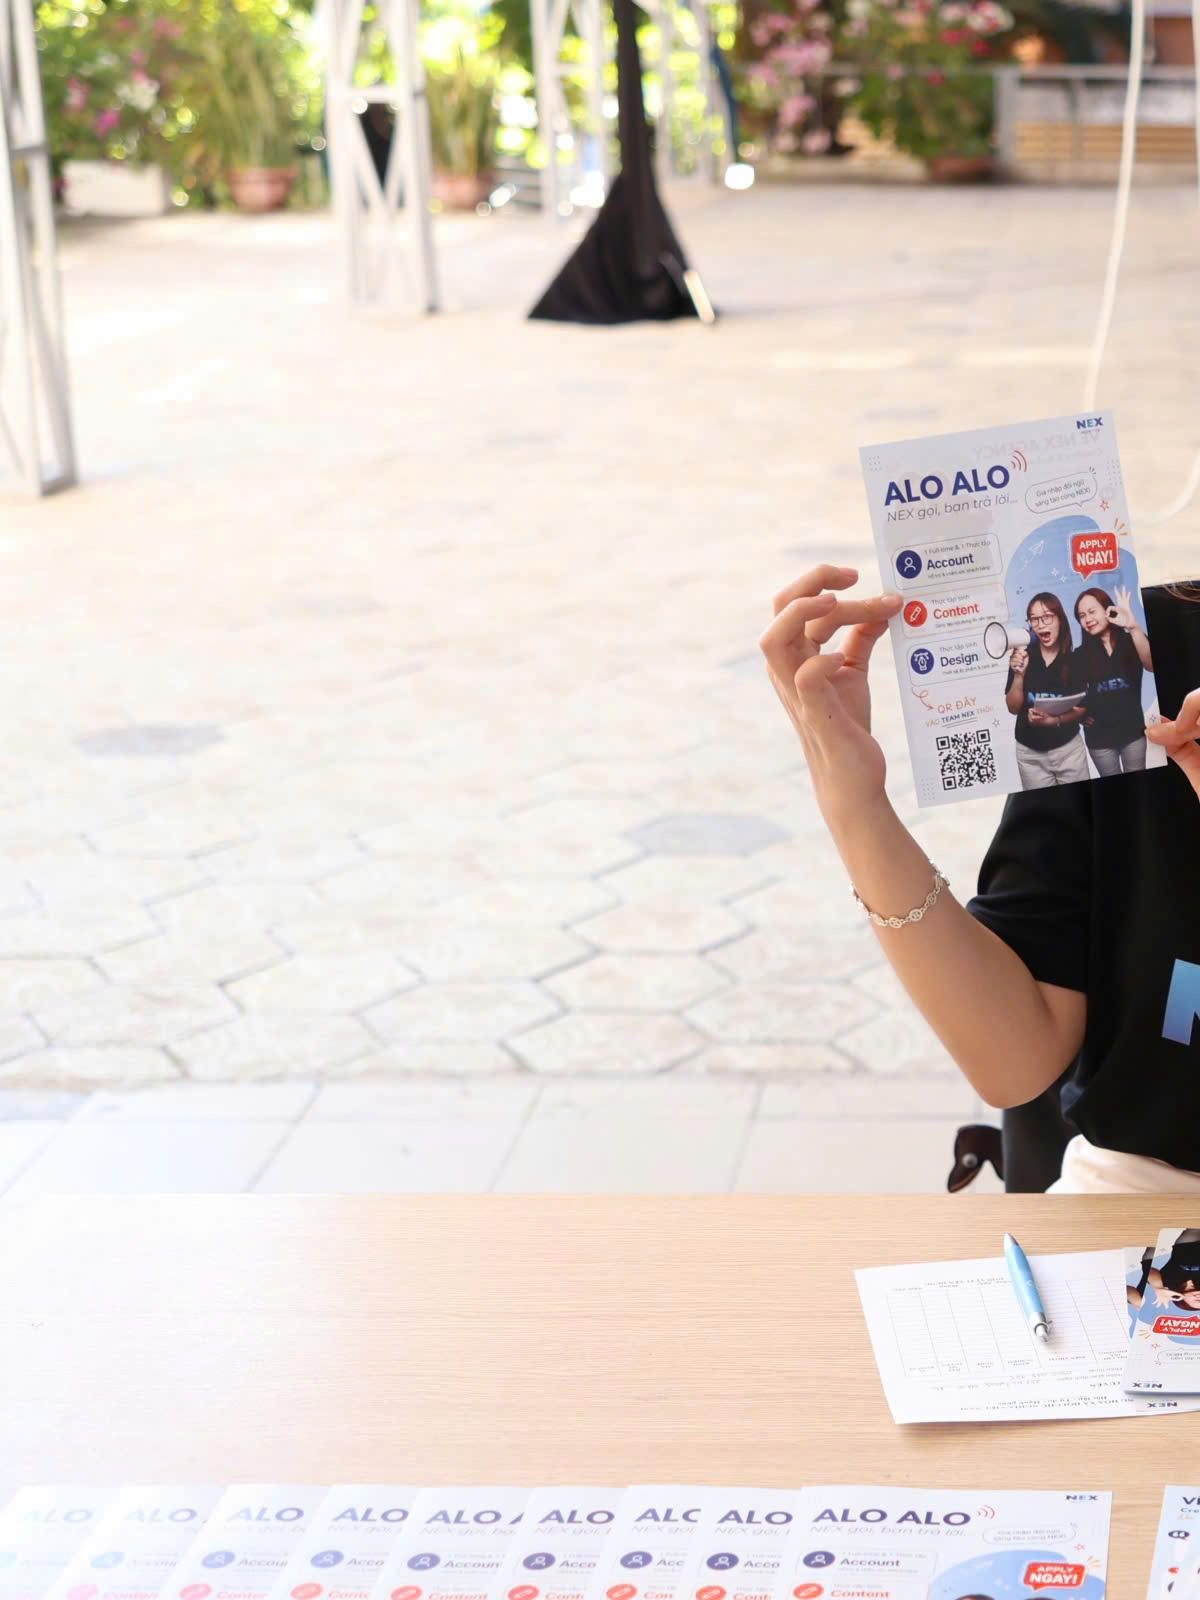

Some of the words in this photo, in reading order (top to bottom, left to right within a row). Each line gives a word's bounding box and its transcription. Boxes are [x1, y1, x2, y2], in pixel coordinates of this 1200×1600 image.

[1076, 417, 1103, 430] NEX
[884, 475, 943, 506] ALO
[952, 465, 1010, 496] ALO
[887, 508, 914, 523] NEX
[973, 495, 991, 509] trả
[1079, 538, 1109, 550] APPLY
[927, 553, 974, 571] Account
[1077, 550, 1114, 567] NGAY!
[933, 603, 980, 620] Content
[940, 653, 979, 668] Design
[938, 703, 953, 714] QR
[942, 714, 961, 724] TEAM
[962, 710, 975, 719] NEX
[1159, 1318, 1200, 1328] NGAY!
[1162, 1326, 1194, 1334] APPLY
[227, 1507, 304, 1522] ALO
[332, 1507, 409, 1523] ALO
[425, 1509, 502, 1524] ALO
[538, 1509, 615, 1524] ALO
[717, 1510, 793, 1525] ALO
[812, 1508, 888, 1523] ALO
[896, 1510, 971, 1526] ALO
[840, 1558, 901, 1567] Account
[1029, 1573, 1078, 1584] NGAY!
[831, 1590, 890, 1599] Content
